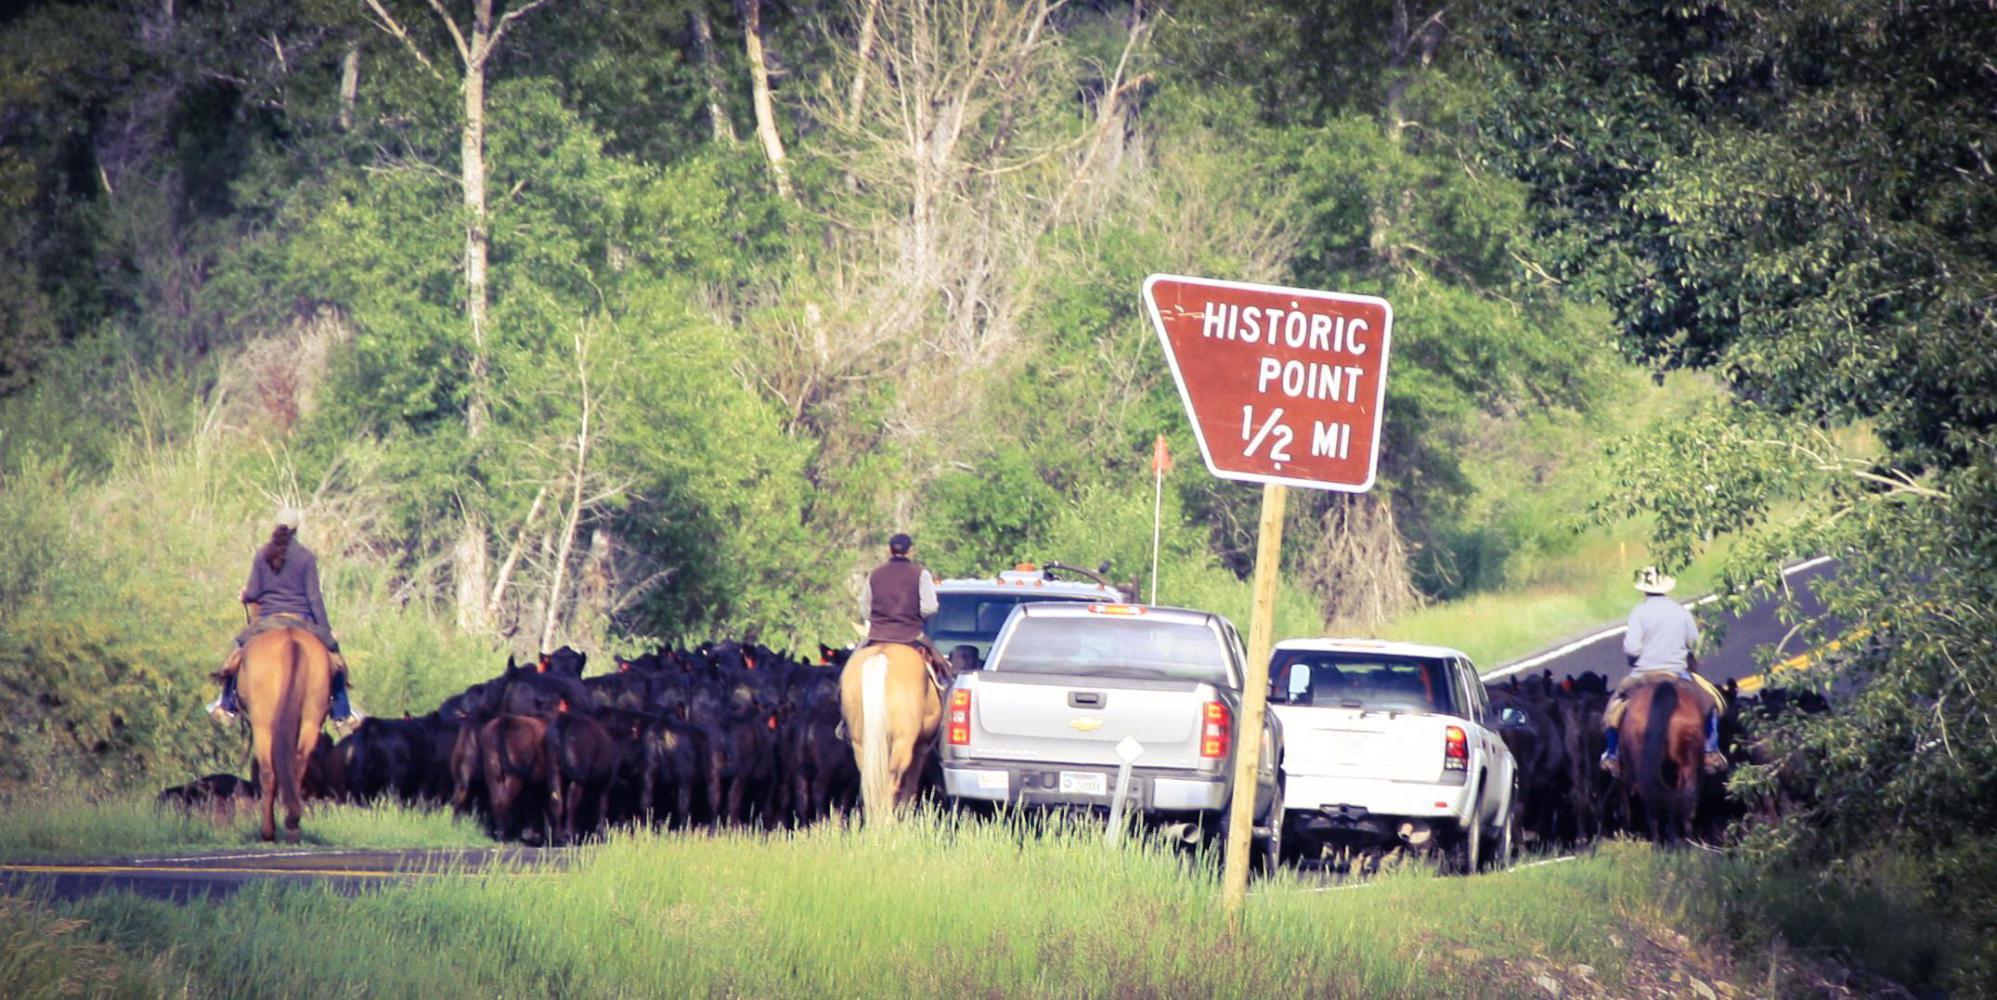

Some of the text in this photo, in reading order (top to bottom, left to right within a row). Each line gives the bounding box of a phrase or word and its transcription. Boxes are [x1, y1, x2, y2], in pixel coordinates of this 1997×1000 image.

[1203, 302, 1368, 355] HISTORIC
[1258, 357, 1363, 403] POINT
[1242, 405, 1350, 461] 1/2 MI
